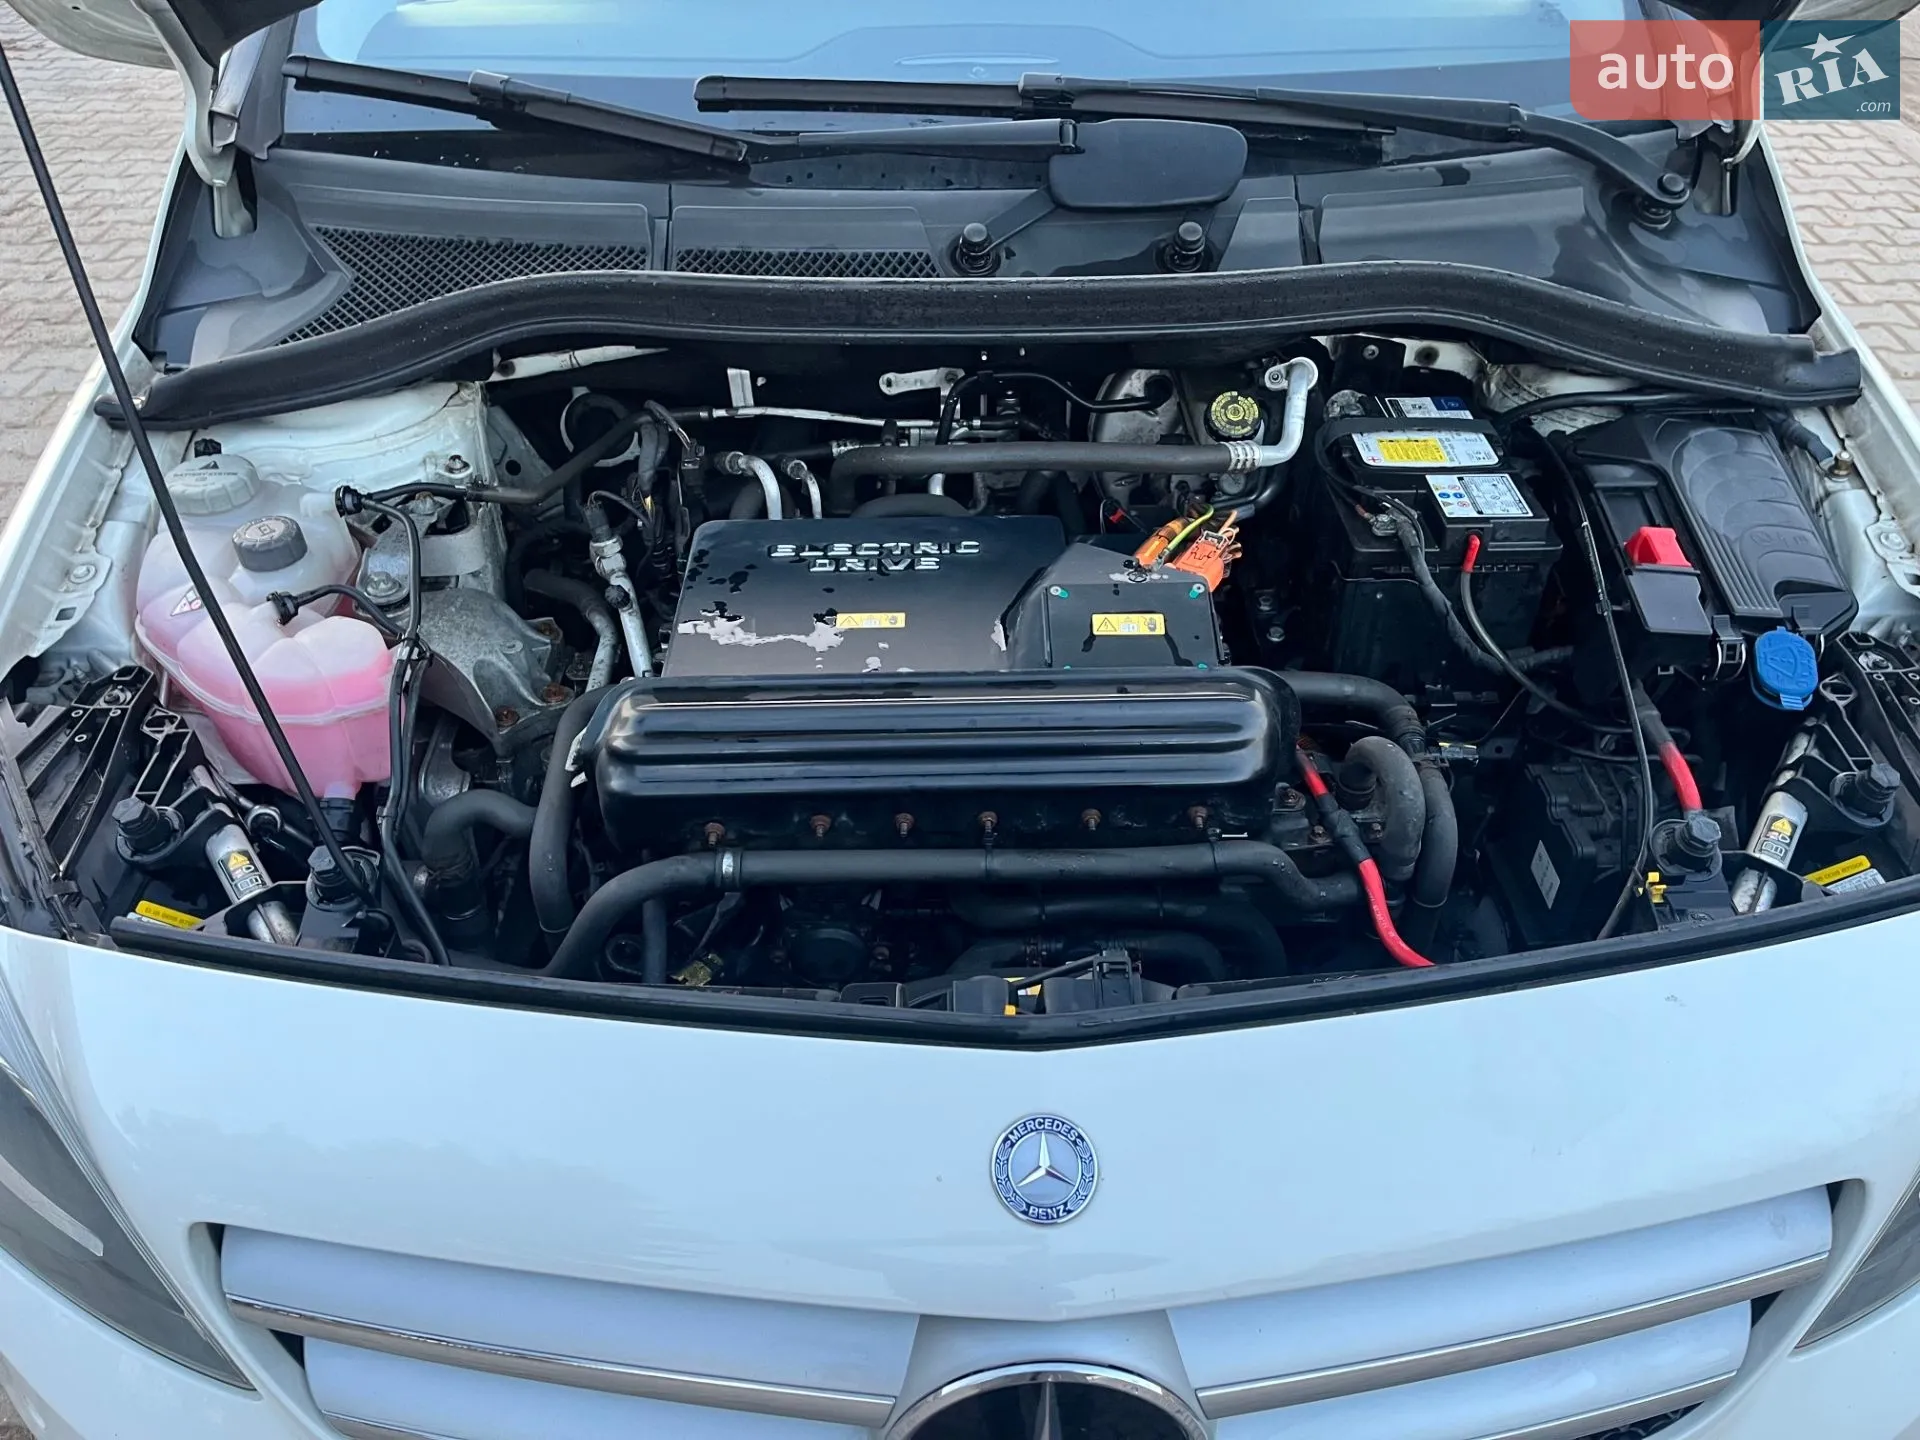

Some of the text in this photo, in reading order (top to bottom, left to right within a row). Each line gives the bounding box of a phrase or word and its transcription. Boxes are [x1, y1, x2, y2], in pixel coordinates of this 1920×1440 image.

[769, 540, 981, 558] ELECTRIC
[808, 557, 941, 572] DRIVE
[1007, 1118, 1078, 1144] MERCEDES
[1028, 1204, 1068, 1220] BENZ
